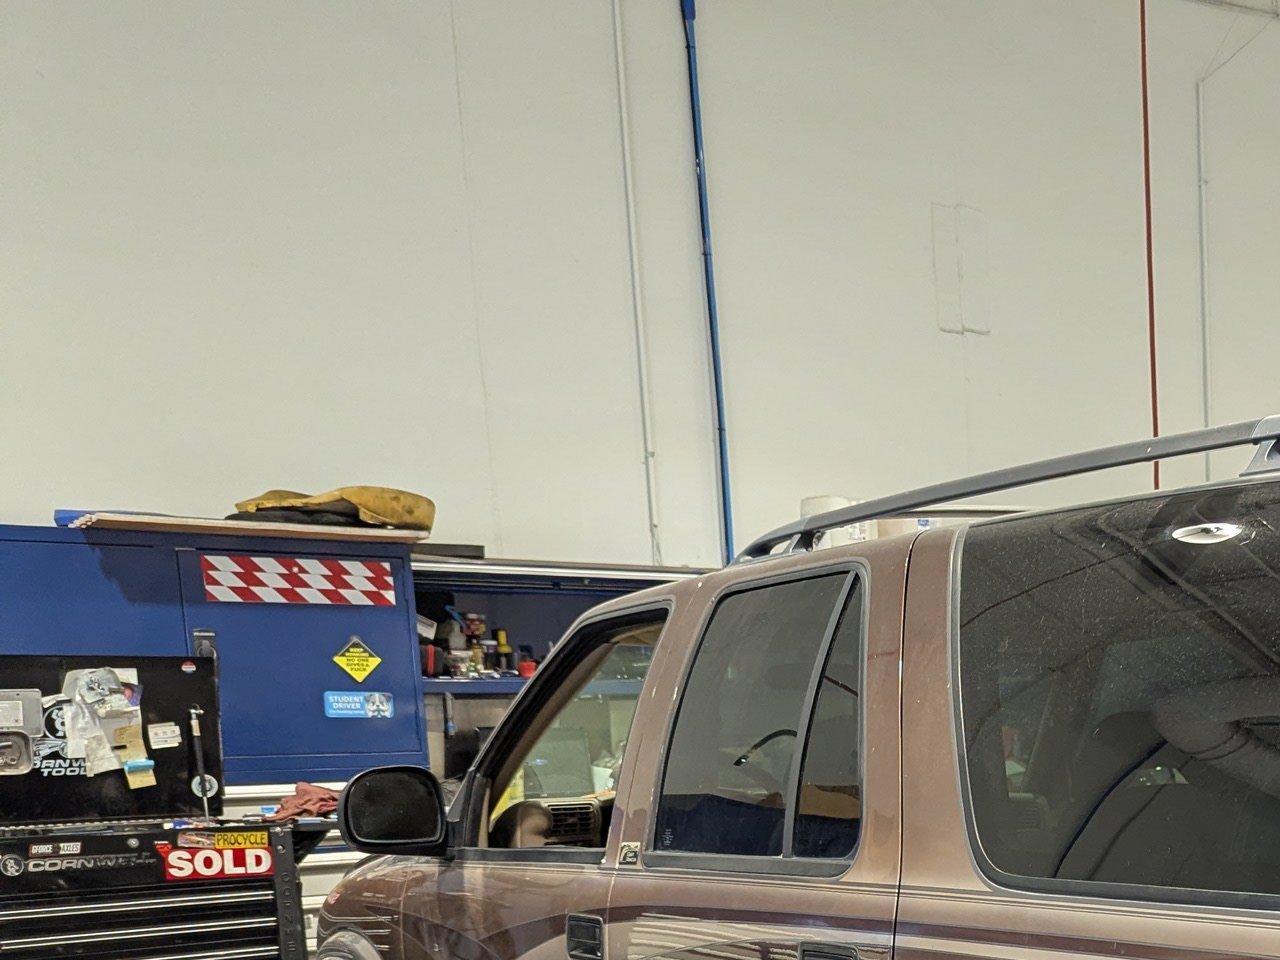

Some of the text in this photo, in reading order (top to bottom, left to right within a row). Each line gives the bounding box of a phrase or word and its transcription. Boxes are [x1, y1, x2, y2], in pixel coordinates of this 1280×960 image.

[328, 695, 364, 703] STUDENT
[332, 702, 361, 710] DRIVER
[41, 767, 87, 777] TOOL
[216, 832, 267, 846] PROCYCLE
[60, 841, 80, 853] AXLES
[167, 848, 273, 878] SOLD
